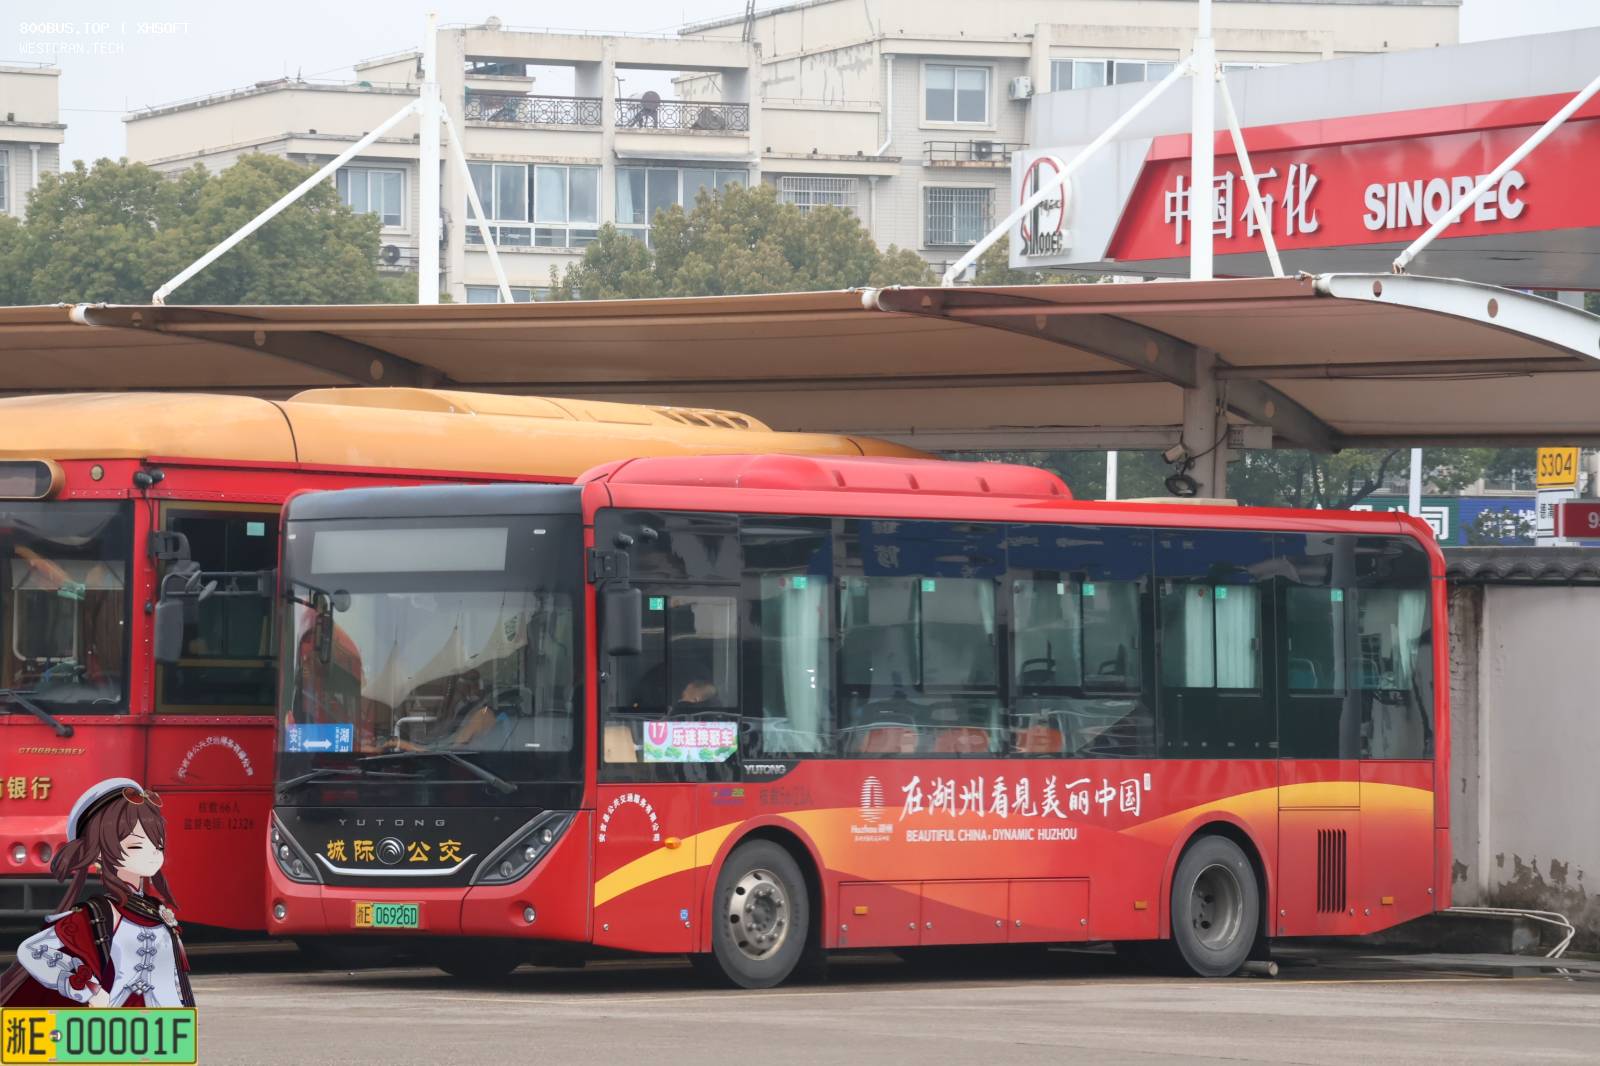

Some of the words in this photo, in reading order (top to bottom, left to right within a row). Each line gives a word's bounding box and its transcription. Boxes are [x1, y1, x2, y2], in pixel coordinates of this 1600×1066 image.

[1165, 163, 1319, 245] 中国石化
[1363, 170, 1526, 231] SINOPEC
[1541, 453, 1572, 477] S304
[1588, 511, 1600, 529] 9
[651, 721, 666, 739] 17
[744, 764, 786, 775] YUTONG
[899, 775, 1141, 822] 在湖州看见美丽中国
[339, 819, 446, 827] YUTONG
[906, 829, 956, 842] BEAUTIFUL
[993, 828, 1035, 841] DYNAMIC
[1038, 828, 1078, 841] HUZHOU
